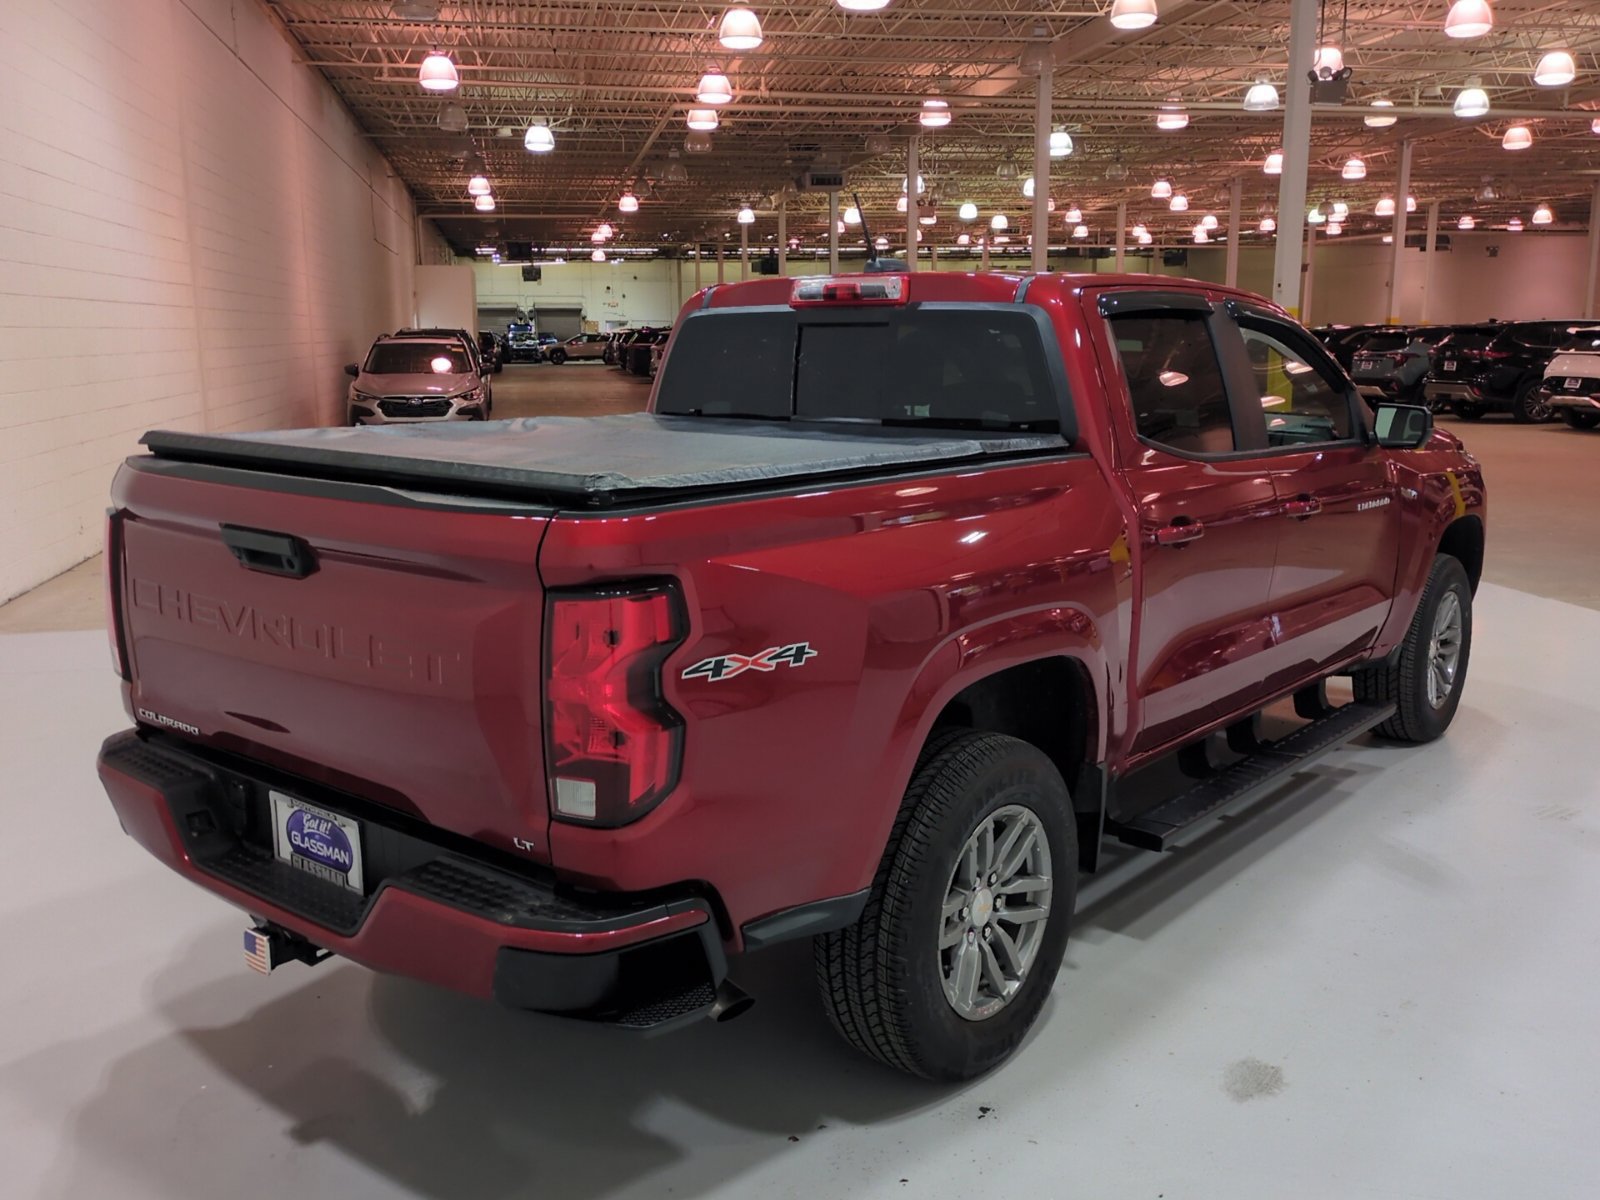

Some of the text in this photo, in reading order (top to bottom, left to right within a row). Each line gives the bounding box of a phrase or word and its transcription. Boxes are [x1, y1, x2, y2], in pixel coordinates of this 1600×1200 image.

[138, 707, 200, 736] COLORADO
[303, 812, 318, 831] Got
[291, 830, 349, 865] GLASSMAN
[512, 836, 534, 853] LT
